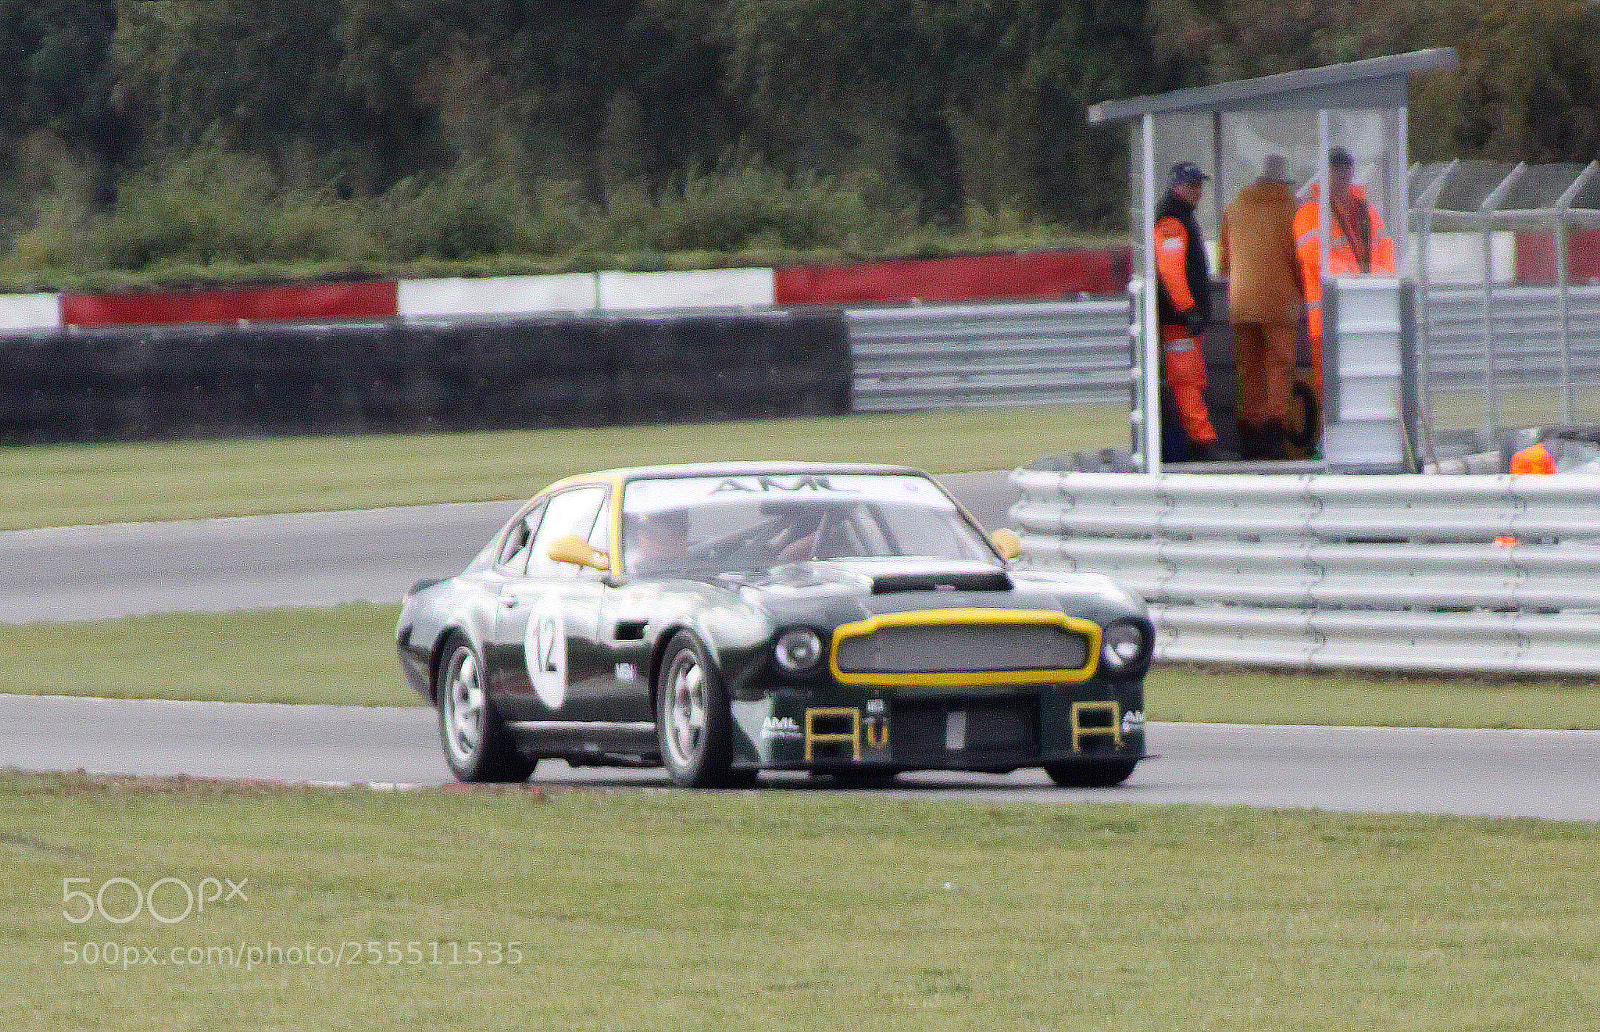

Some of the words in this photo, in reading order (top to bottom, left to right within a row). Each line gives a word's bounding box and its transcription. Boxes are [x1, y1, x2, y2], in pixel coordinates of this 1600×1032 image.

[708, 475, 861, 495] AML
[533, 617, 557, 672] 12
[761, 716, 800, 731] AML
